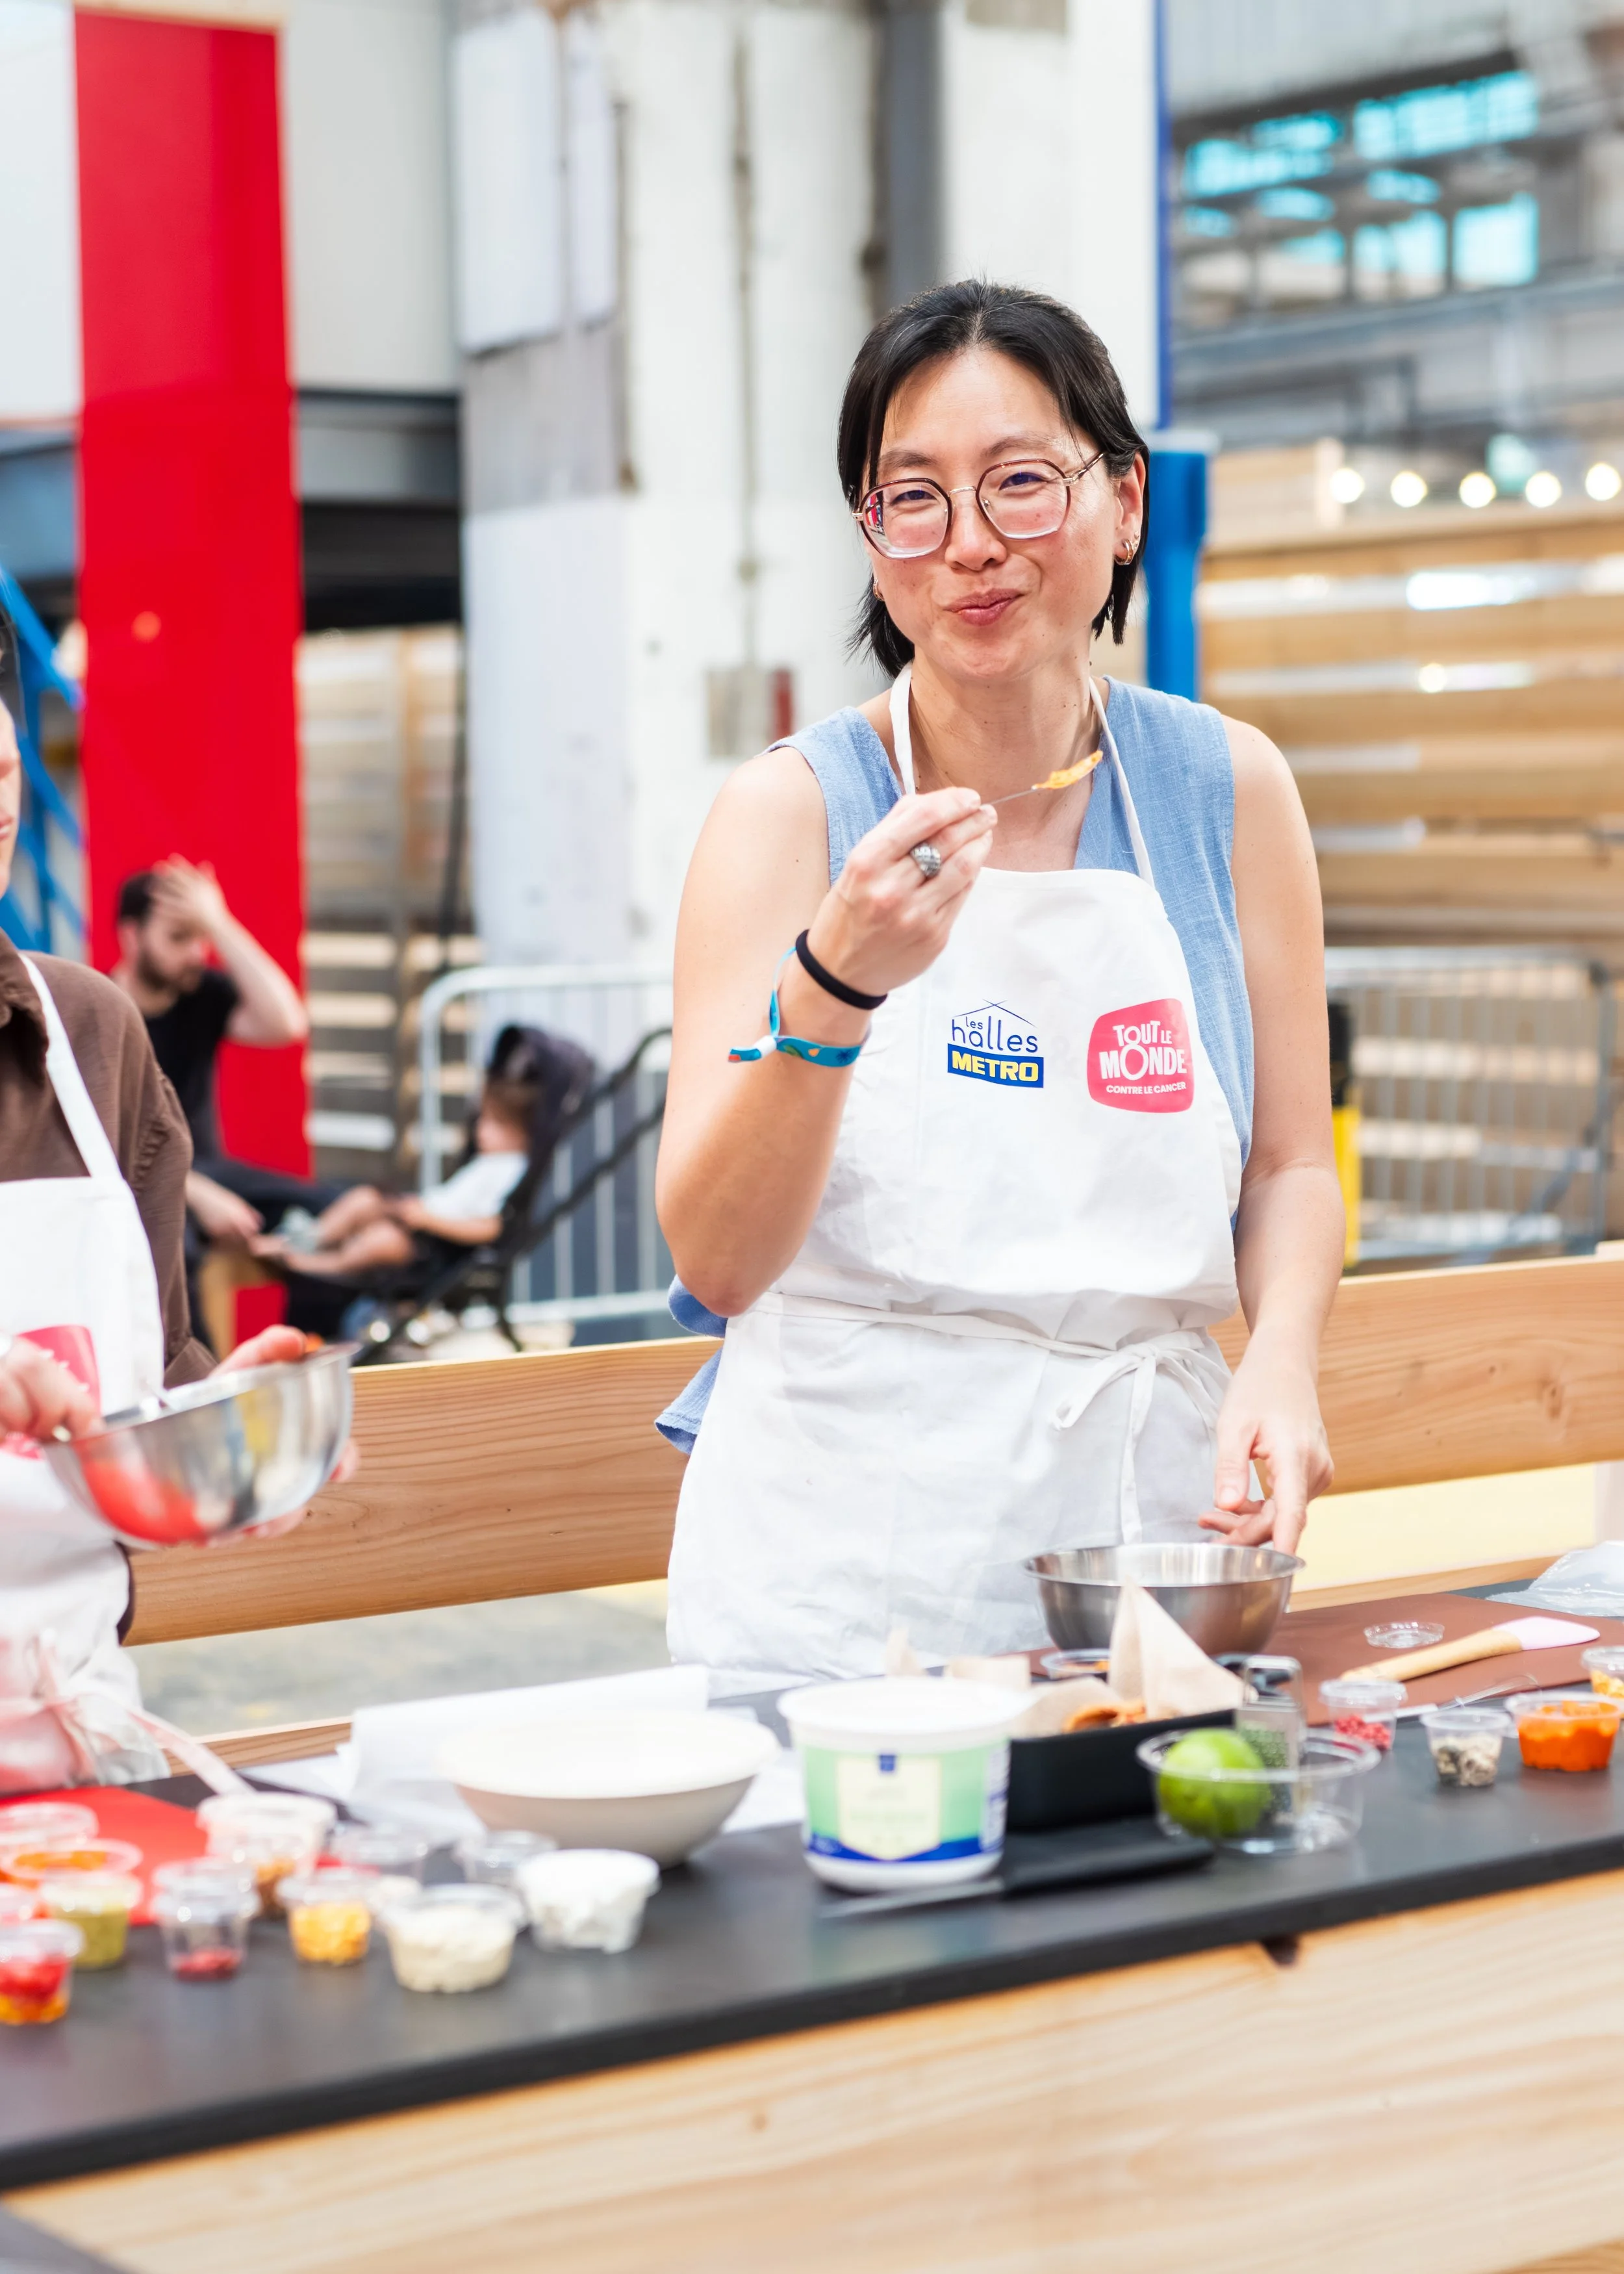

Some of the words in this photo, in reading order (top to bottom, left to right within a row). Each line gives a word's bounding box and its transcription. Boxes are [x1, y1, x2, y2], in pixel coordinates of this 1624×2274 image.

[952, 1016, 1039, 1053] halles
[965, 1016, 983, 1030] les
[1112, 1020, 1161, 1047] TOUT
[1161, 1030, 1173, 1044] LE
[952, 1050, 1039, 1082] METRO
[1099, 1043, 1187, 1080] MONDE
[1106, 1084, 1143, 1095] CONTRE
[1143, 1086, 1153, 1094] LE
[1153, 1081, 1187, 1093] CANCER
